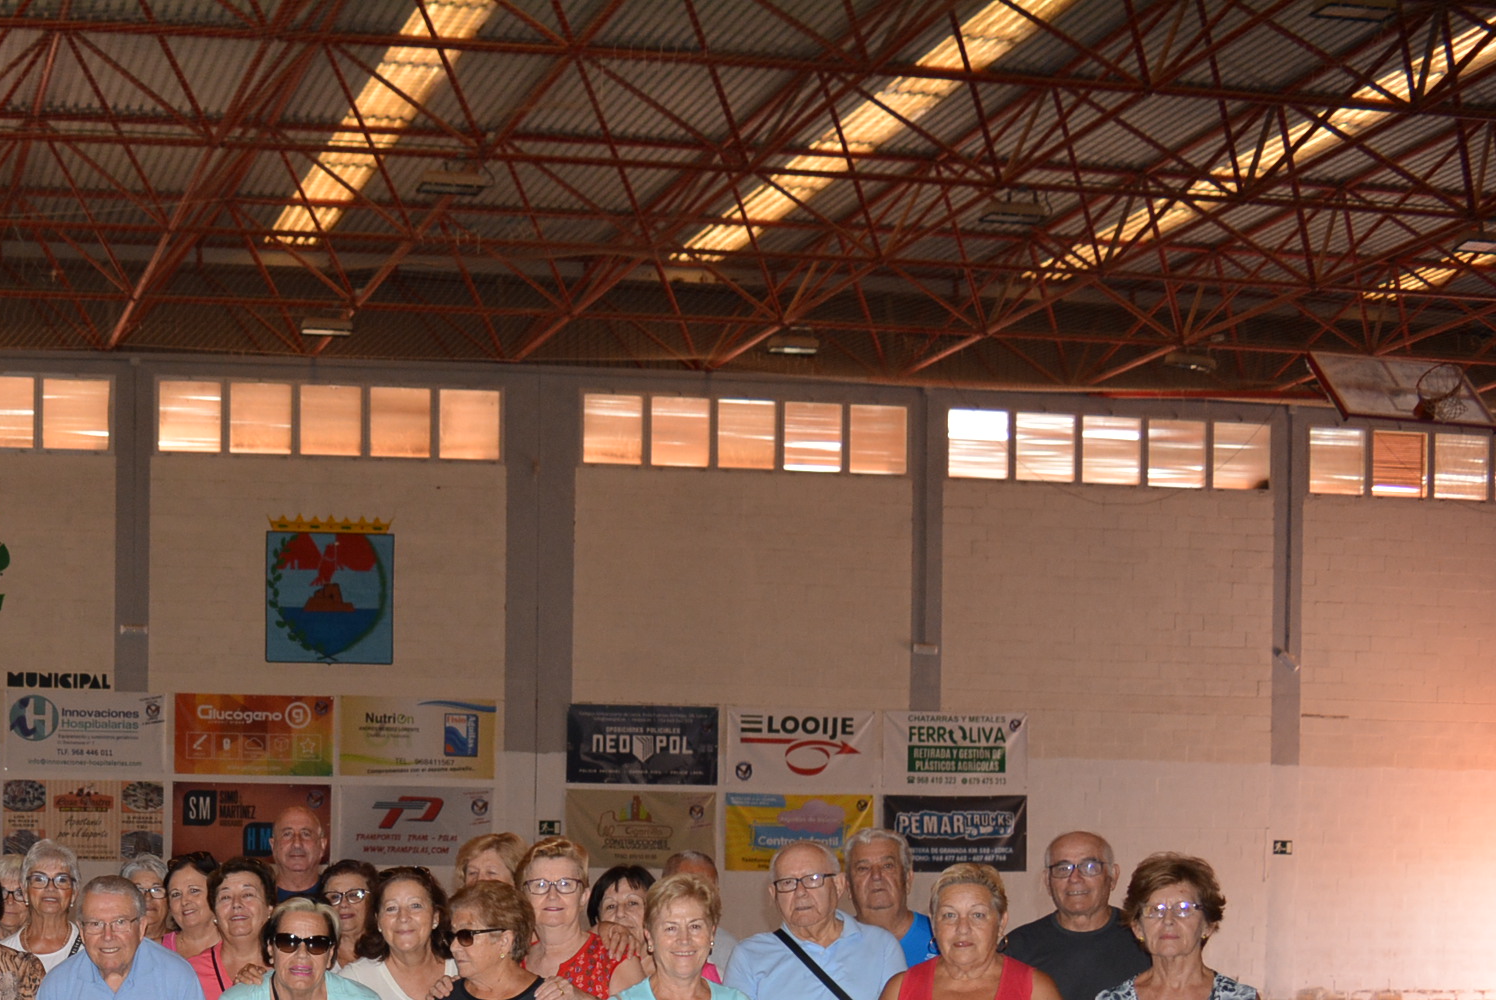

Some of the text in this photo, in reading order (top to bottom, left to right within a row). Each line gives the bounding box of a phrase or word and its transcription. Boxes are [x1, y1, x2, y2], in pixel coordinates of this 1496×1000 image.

[7, 671, 111, 690] MUNICIPAL
[61, 707, 140, 719] Innovaciones
[196, 704, 283, 724] Glucógeno
[908, 714, 1007, 724] CHATARRAS Y METALES
[61, 718, 140, 731] Hospitalarias
[767, 715, 854, 740] LOOIJE
[71, 749, 84, 757] 968
[913, 746, 1002, 760] RETIRADA Y GESTIÓN DE
[915, 758, 1000, 771] PLÁSTICOS AGRÍCOLAS
[916, 776, 929, 784] 968
[898, 813, 1012, 835] PEMAR TRUCKS
[356, 833, 402, 842] TRANSPORTES
